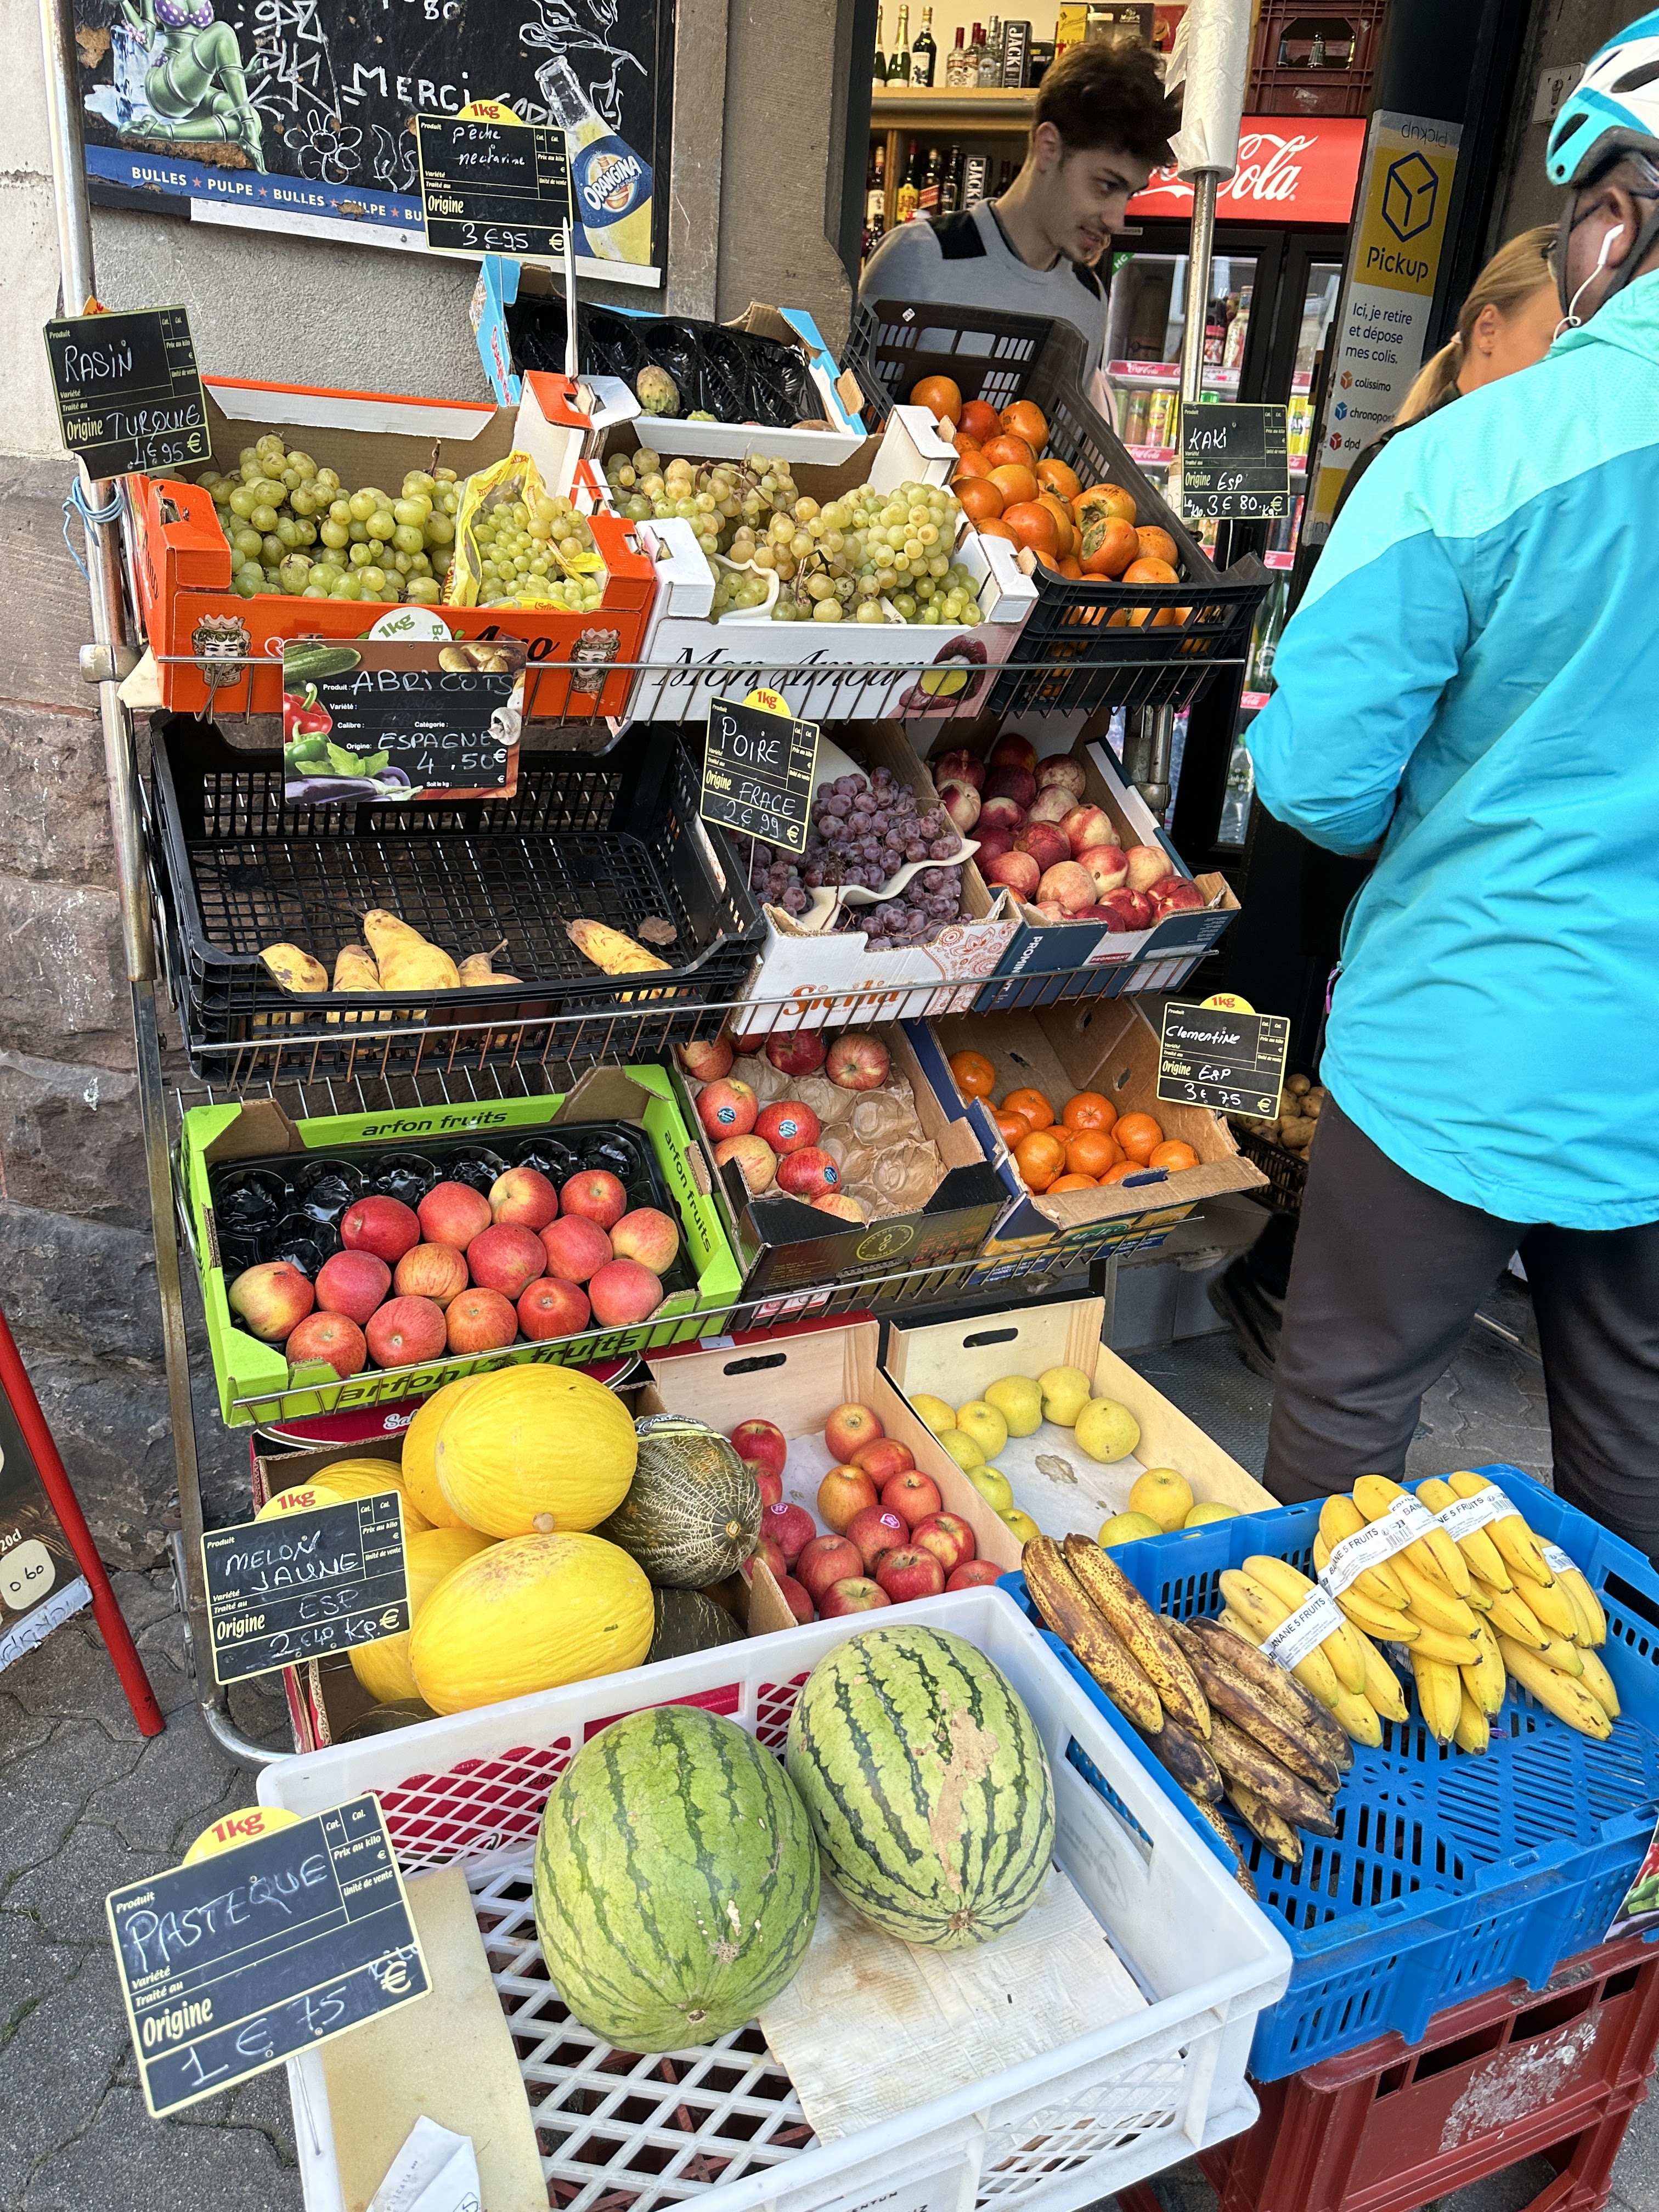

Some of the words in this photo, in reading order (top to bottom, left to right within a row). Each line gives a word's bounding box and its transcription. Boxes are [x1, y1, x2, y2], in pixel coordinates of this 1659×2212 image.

[471, 104, 500, 119] 1kg
[459, 146, 525, 166] nectarine
[132, 167, 187, 186] BULLES
[208, 178, 253, 196] PULPE
[274, 188, 324, 206] BULLES
[584, 156, 642, 210] ORANGINA
[428, 195, 464, 215] Origine
[549, 233, 564, 251] €
[1367, 246, 1428, 283] Pickup
[1353, 303, 1368, 319] Ici,
[1369, 305, 1381, 321] je
[1383, 310, 1412, 325] retire
[49, 330, 70, 339] Produit
[1349, 325, 1361, 337] et
[1363, 328, 1403, 344] dépose
[1346, 346, 1369, 359] mes
[1372, 349, 1398, 364] colis.
[60, 389, 81, 398] Variété
[1355, 378, 1391, 392] colissimo
[62, 403, 79, 411] Traité
[67, 417, 104, 441] Origine
[187, 432, 202, 453] €
[1345, 438, 1361, 450] dpd
[1185, 471, 1211, 488] Origine
[1207, 495, 1218, 515] 3
[377, 613, 416, 639] 1kg
[651, 647, 764, 688] Mon
[769, 649, 926, 688] Amour
[712, 704, 727, 713] Produit
[757, 691, 777, 709] 1kg
[377, 731, 493, 751] ESPAGNE
[721, 716, 781, 764] POIRE
[708, 747, 724, 757] Variété
[706, 770, 732, 791] Origine
[739, 782, 795, 816] FRACE
[786, 825, 799, 844] €
[1003, 936, 1043, 991] PROMINNT
[1211, 997, 1235, 1008] 1kg
[1162, 1060, 1191, 1076] Origine
[1257, 1098, 1272, 1113] €
[362, 1119, 433, 1138] arfon
[439, 1109, 509, 1131] fruits
[663, 1128, 689, 1184] arfon
[682, 1176, 712, 1254] fruits
[339, 1368, 460, 1405] arfon
[529, 1333, 640, 1365] fruits
[277, 1490, 316, 1510] 1kg
[360, 1505, 371, 1514] Cat.
[1457, 1497, 1484, 1514] FRUITS
[363, 1526, 375, 1534] Prix
[386, 1521, 398, 1529] kilo
[1342, 1545, 1348, 1554] 5
[1348, 1528, 1379, 1549] FRUITS
[206, 1537, 235, 1549] Produit
[225, 1530, 321, 1577] MELON
[365, 1552, 379, 1561] Unité
[387, 1546, 402, 1556] vente
[251, 1553, 358, 1592] JAUNE
[212, 1589, 240, 1602] Variété
[213, 1602, 236, 1614] Traité
[237, 1601, 247, 1609] au
[217, 1614, 266, 1640] Origine
[298, 1589, 359, 1620] ESP
[1294, 1618, 1301, 1627] 5
[1299, 1597, 1326, 1623] FRUITS
[379, 1608, 400, 1629] €
[211, 1812, 266, 1843] 1kg
[326, 1819, 341, 1831] Cat.
[352, 1809, 366, 1821] Cal.
[334, 1846, 351, 1860] Prix
[352, 1841, 364, 1852] au
[365, 1834, 382, 1848] kilo
[377, 1850, 386, 1860] €
[343, 1882, 363, 1897] Unité
[363, 1876, 373, 1886] de
[373, 1870, 393, 1884] vente
[115, 1891, 156, 1914] Produit
[132, 1966, 171, 1990] Variété
[381, 1960, 412, 1995] €
[135, 1987, 167, 2007] Traité
[168, 1980, 183, 1994] au
[143, 1997, 214, 2049] Origine
[181, 2045, 229, 2087] 1
